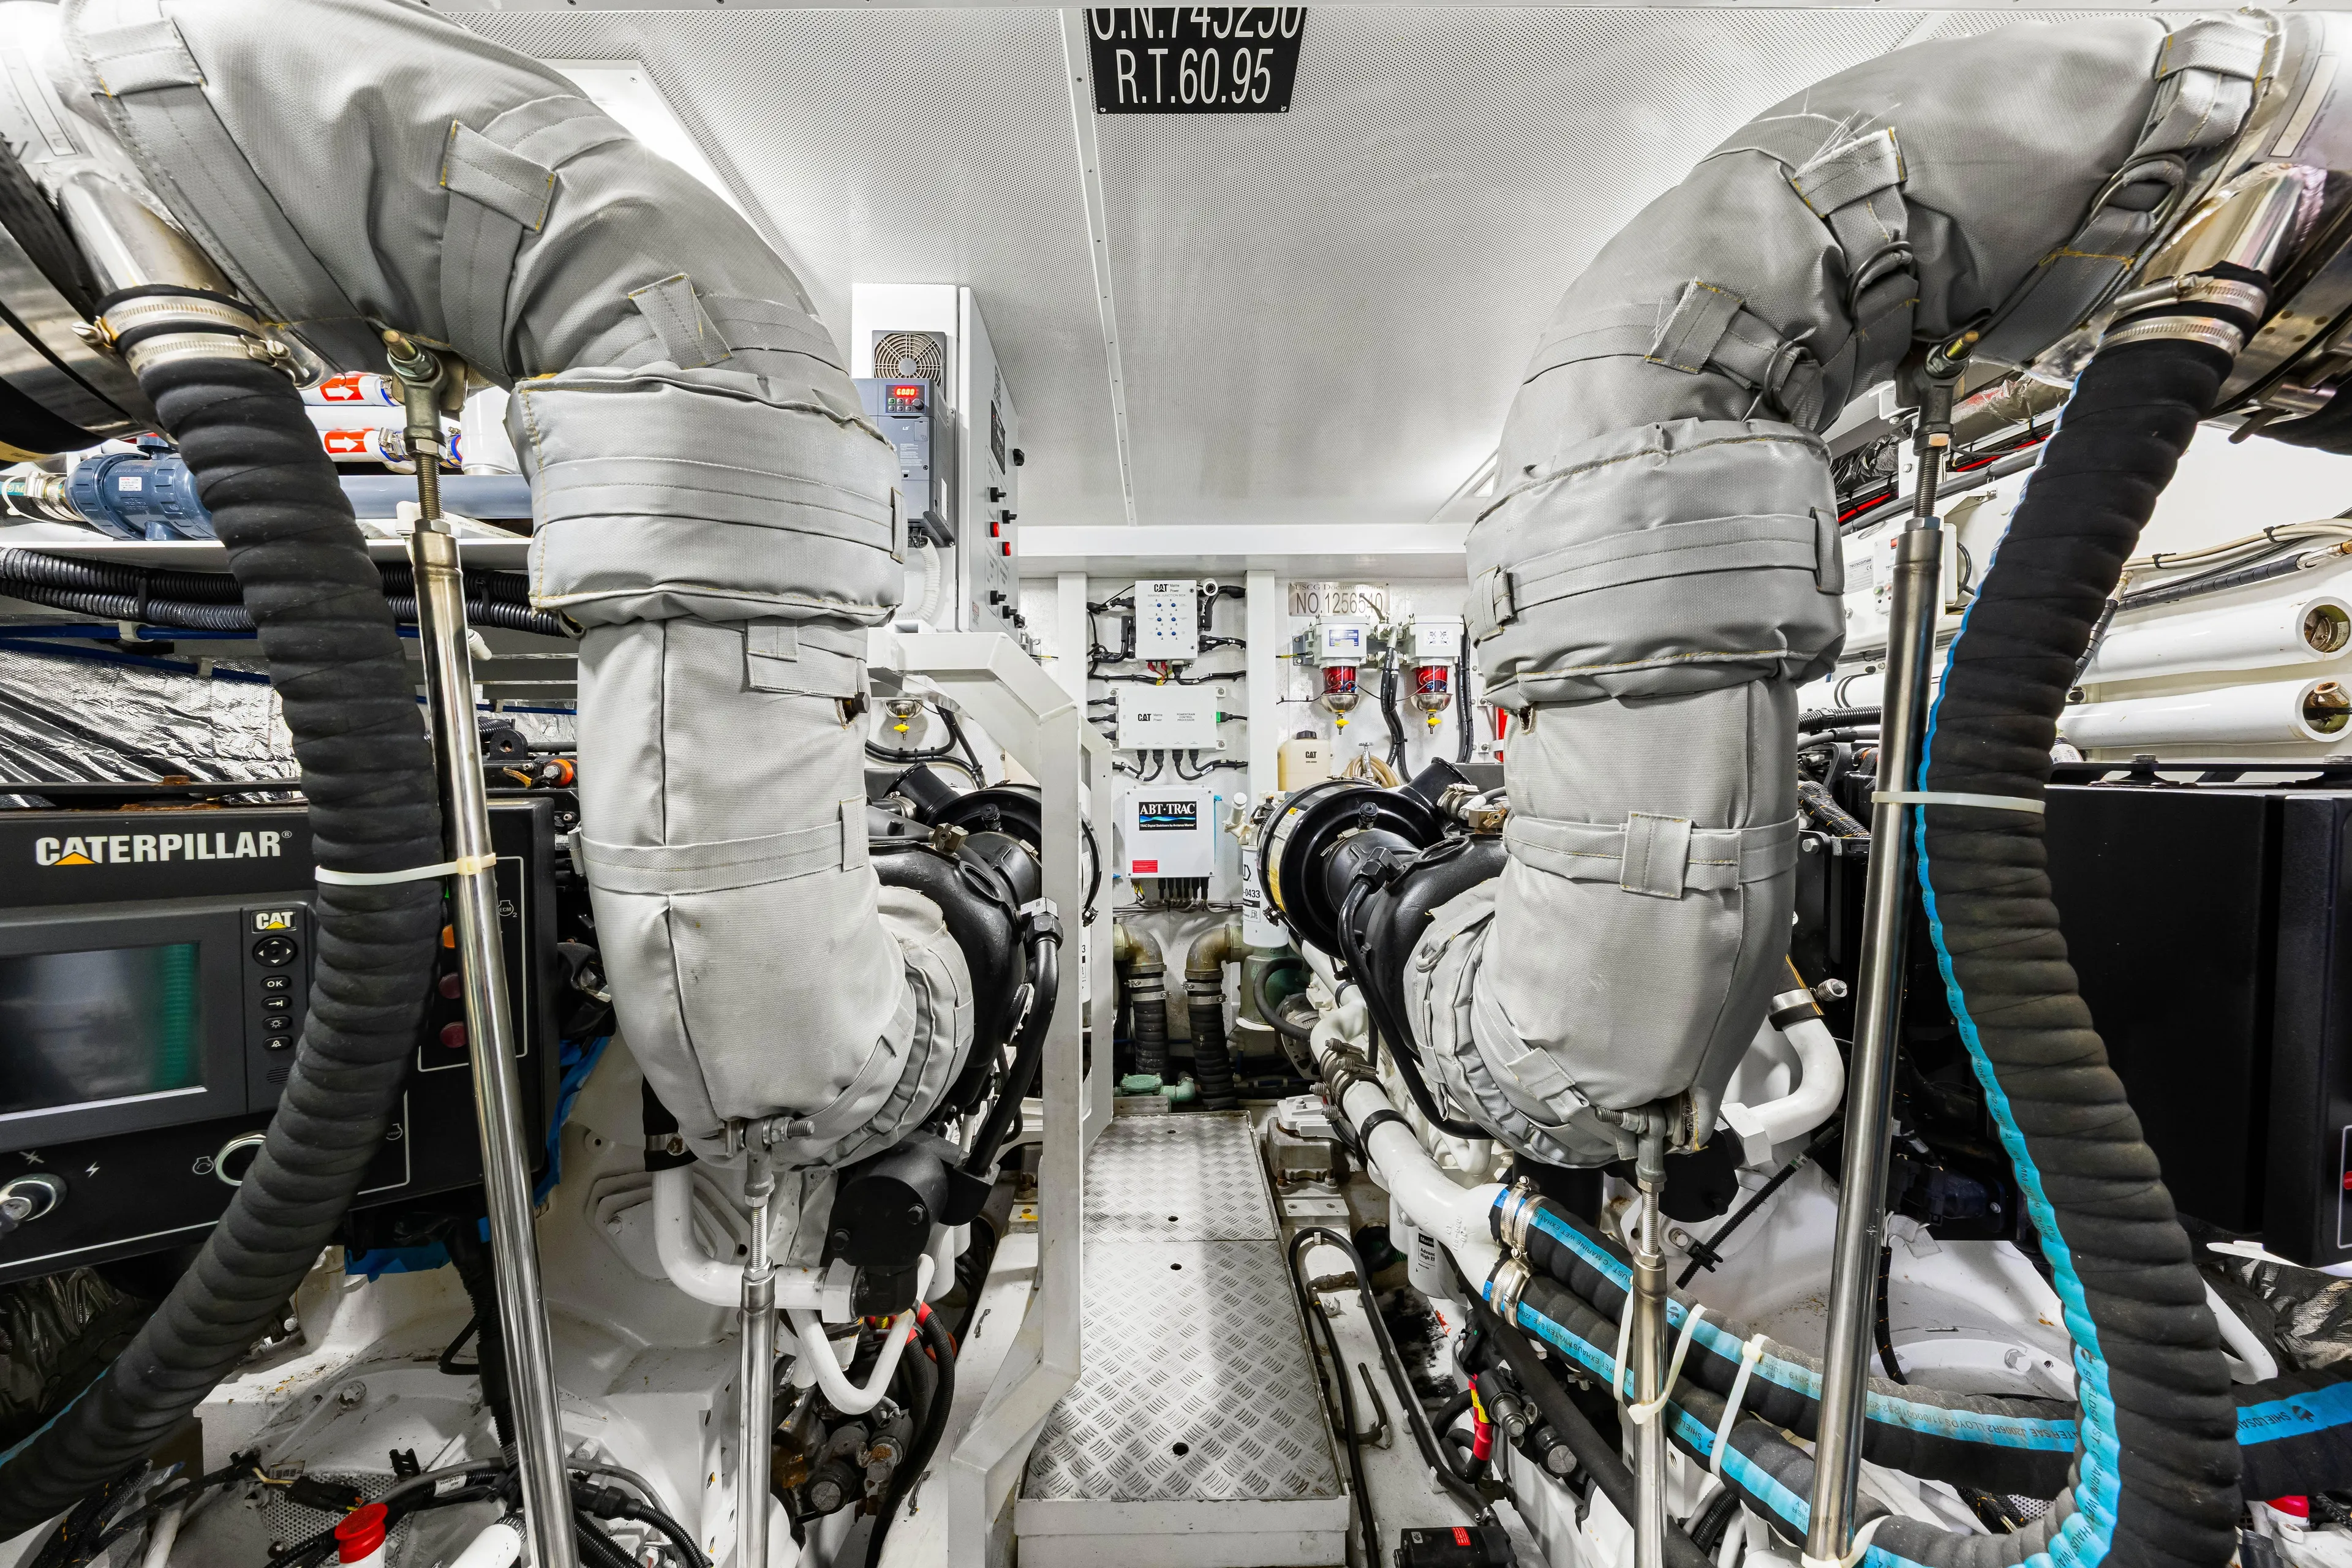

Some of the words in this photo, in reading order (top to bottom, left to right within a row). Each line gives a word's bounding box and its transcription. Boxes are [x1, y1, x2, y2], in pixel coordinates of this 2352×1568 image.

[1115, 48, 1274, 104] R.T.60.95
[1154, 584, 1168, 592] CAT
[36, 831, 281, 866] CATERPILLAR
[255, 911, 293, 930] CAT
[1561, 1229, 1576, 1242] WET
[1575, 1238, 1603, 1261] MARINE
[1599, 1358, 1615, 1375] WET
[1765, 1371, 1776, 1379] BY
[1789, 1371, 1810, 1385] 2019
[1945, 1418, 1987, 1431] LLOYDS
[2032, 1428, 2049, 1439] SAE
